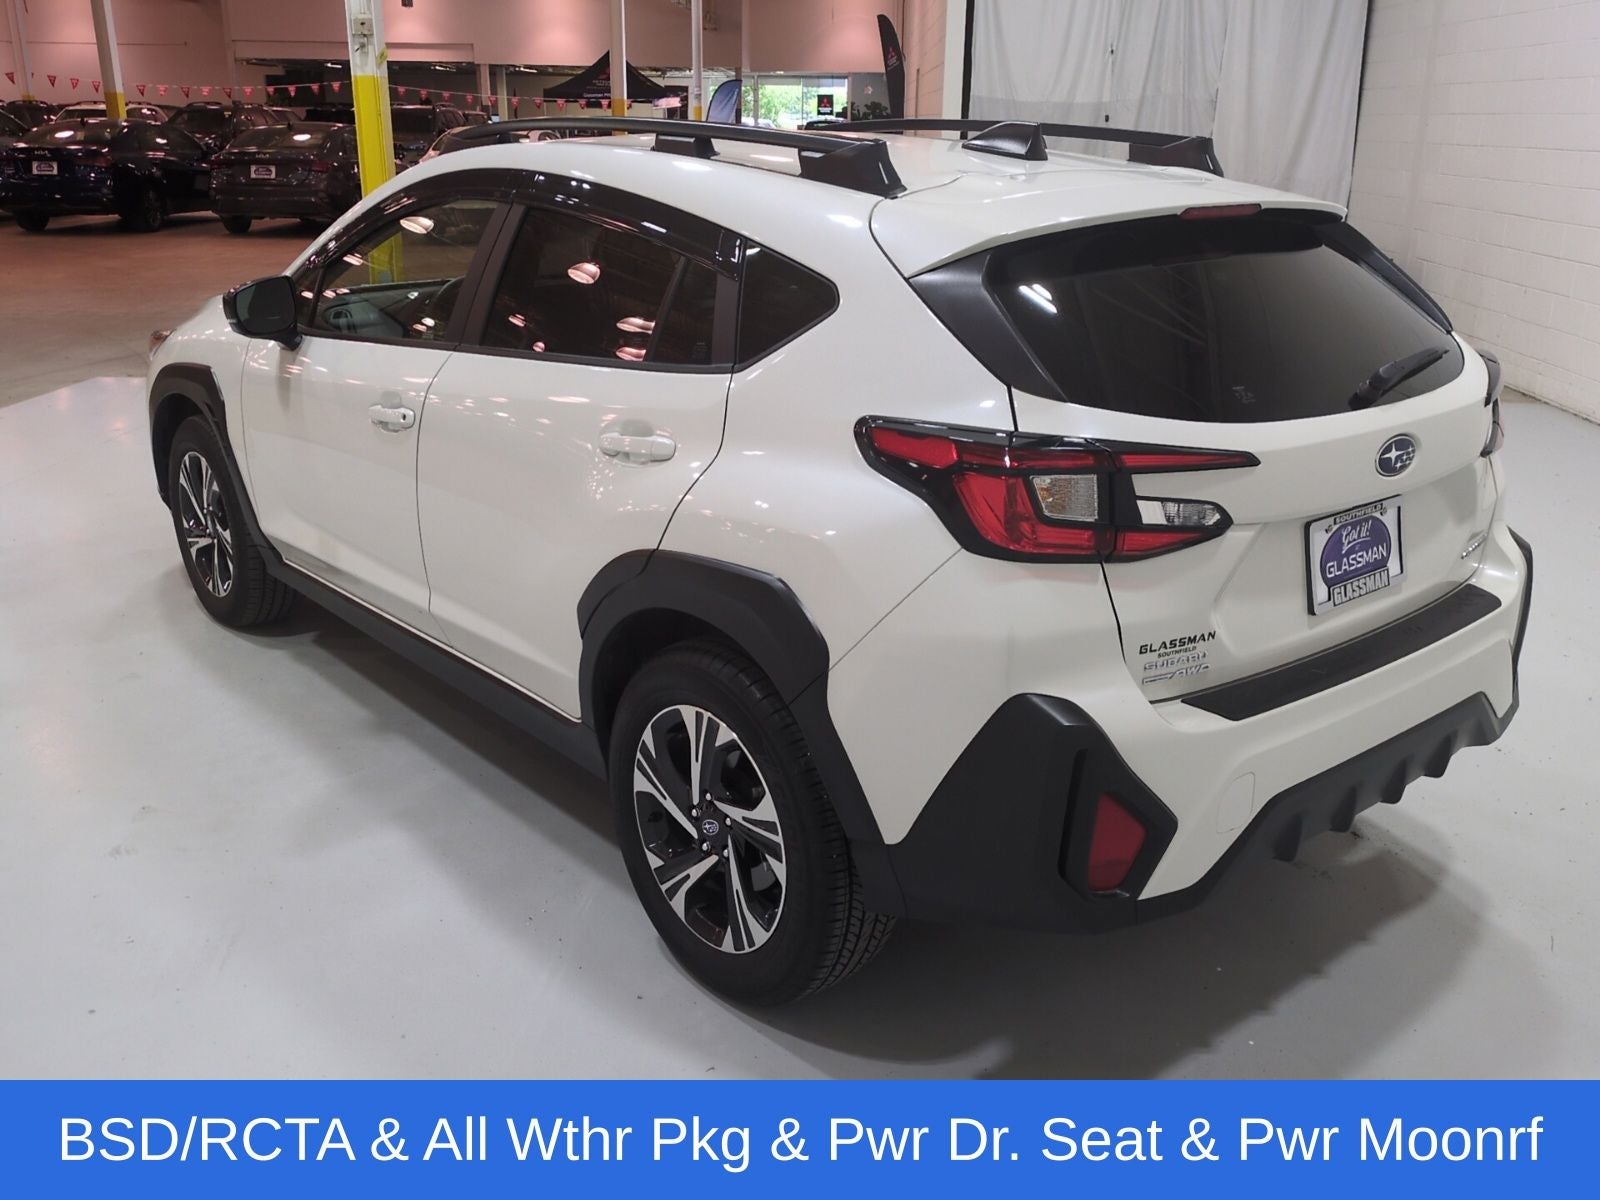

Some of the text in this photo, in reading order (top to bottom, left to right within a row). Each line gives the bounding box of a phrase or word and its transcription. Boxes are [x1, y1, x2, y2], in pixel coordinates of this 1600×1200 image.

[1335, 505, 1383, 524] SOUTHFIELD
[1341, 519, 1372, 549] Got it!
[1326, 542, 1387, 578] GLASSMAN
[1333, 569, 1388, 605] GLASSMAN
[1139, 630, 1216, 655] GLASSMAN
[1157, 645, 1197, 659] SOUTHFIELD
[1143, 651, 1207, 672] SUBARU
